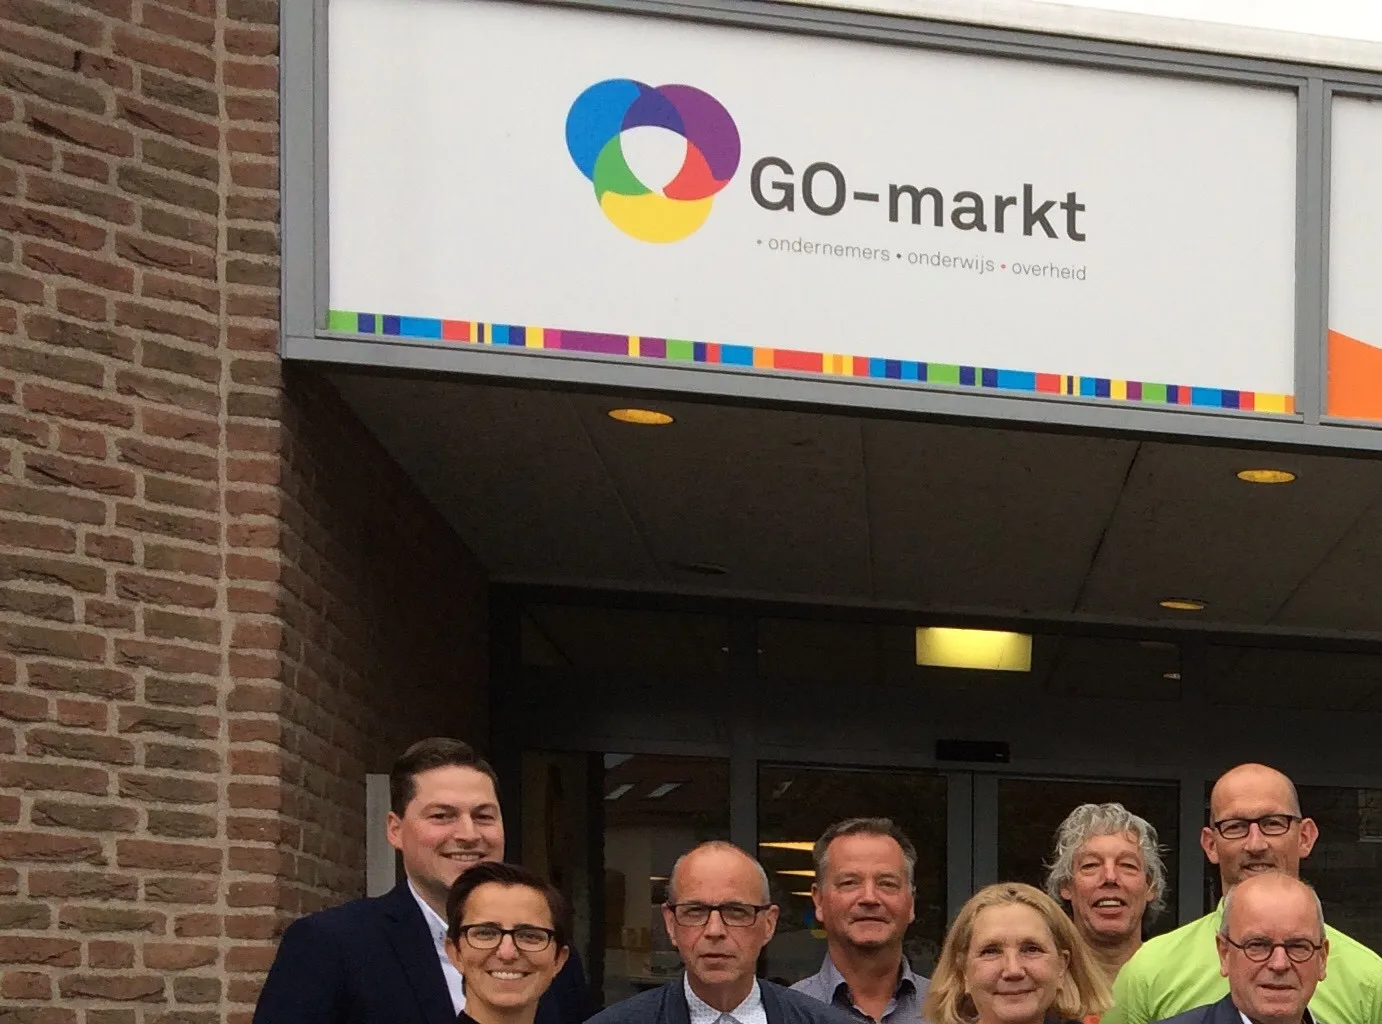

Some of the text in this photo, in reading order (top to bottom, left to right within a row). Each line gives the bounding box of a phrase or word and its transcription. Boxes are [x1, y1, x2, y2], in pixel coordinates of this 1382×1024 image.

[750, 156, 1086, 242] GO-markt
[768, 237, 1087, 281] ondernemers onderwijs overheid
